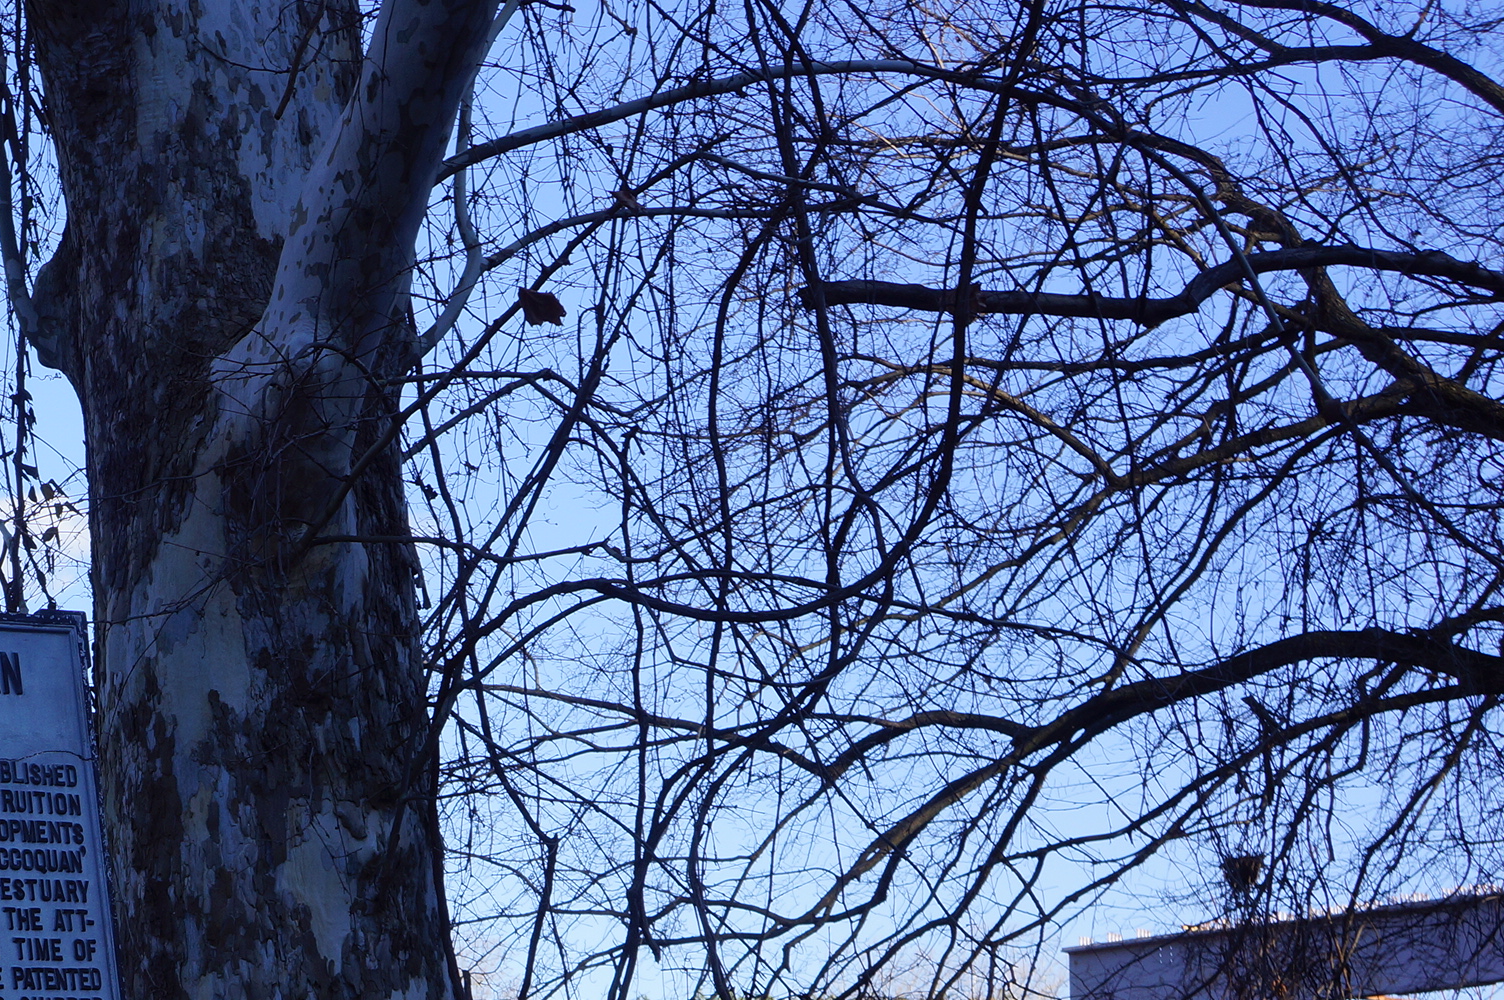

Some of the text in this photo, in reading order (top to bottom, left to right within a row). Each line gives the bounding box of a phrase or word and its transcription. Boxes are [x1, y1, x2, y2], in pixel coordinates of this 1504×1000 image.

[1, 907, 43, 932] THE
[52, 909, 95, 933] ATT-
[11, 937, 64, 963] TIME
[72, 938, 97, 962] OF
[10, 966, 102, 992] PATENTED
